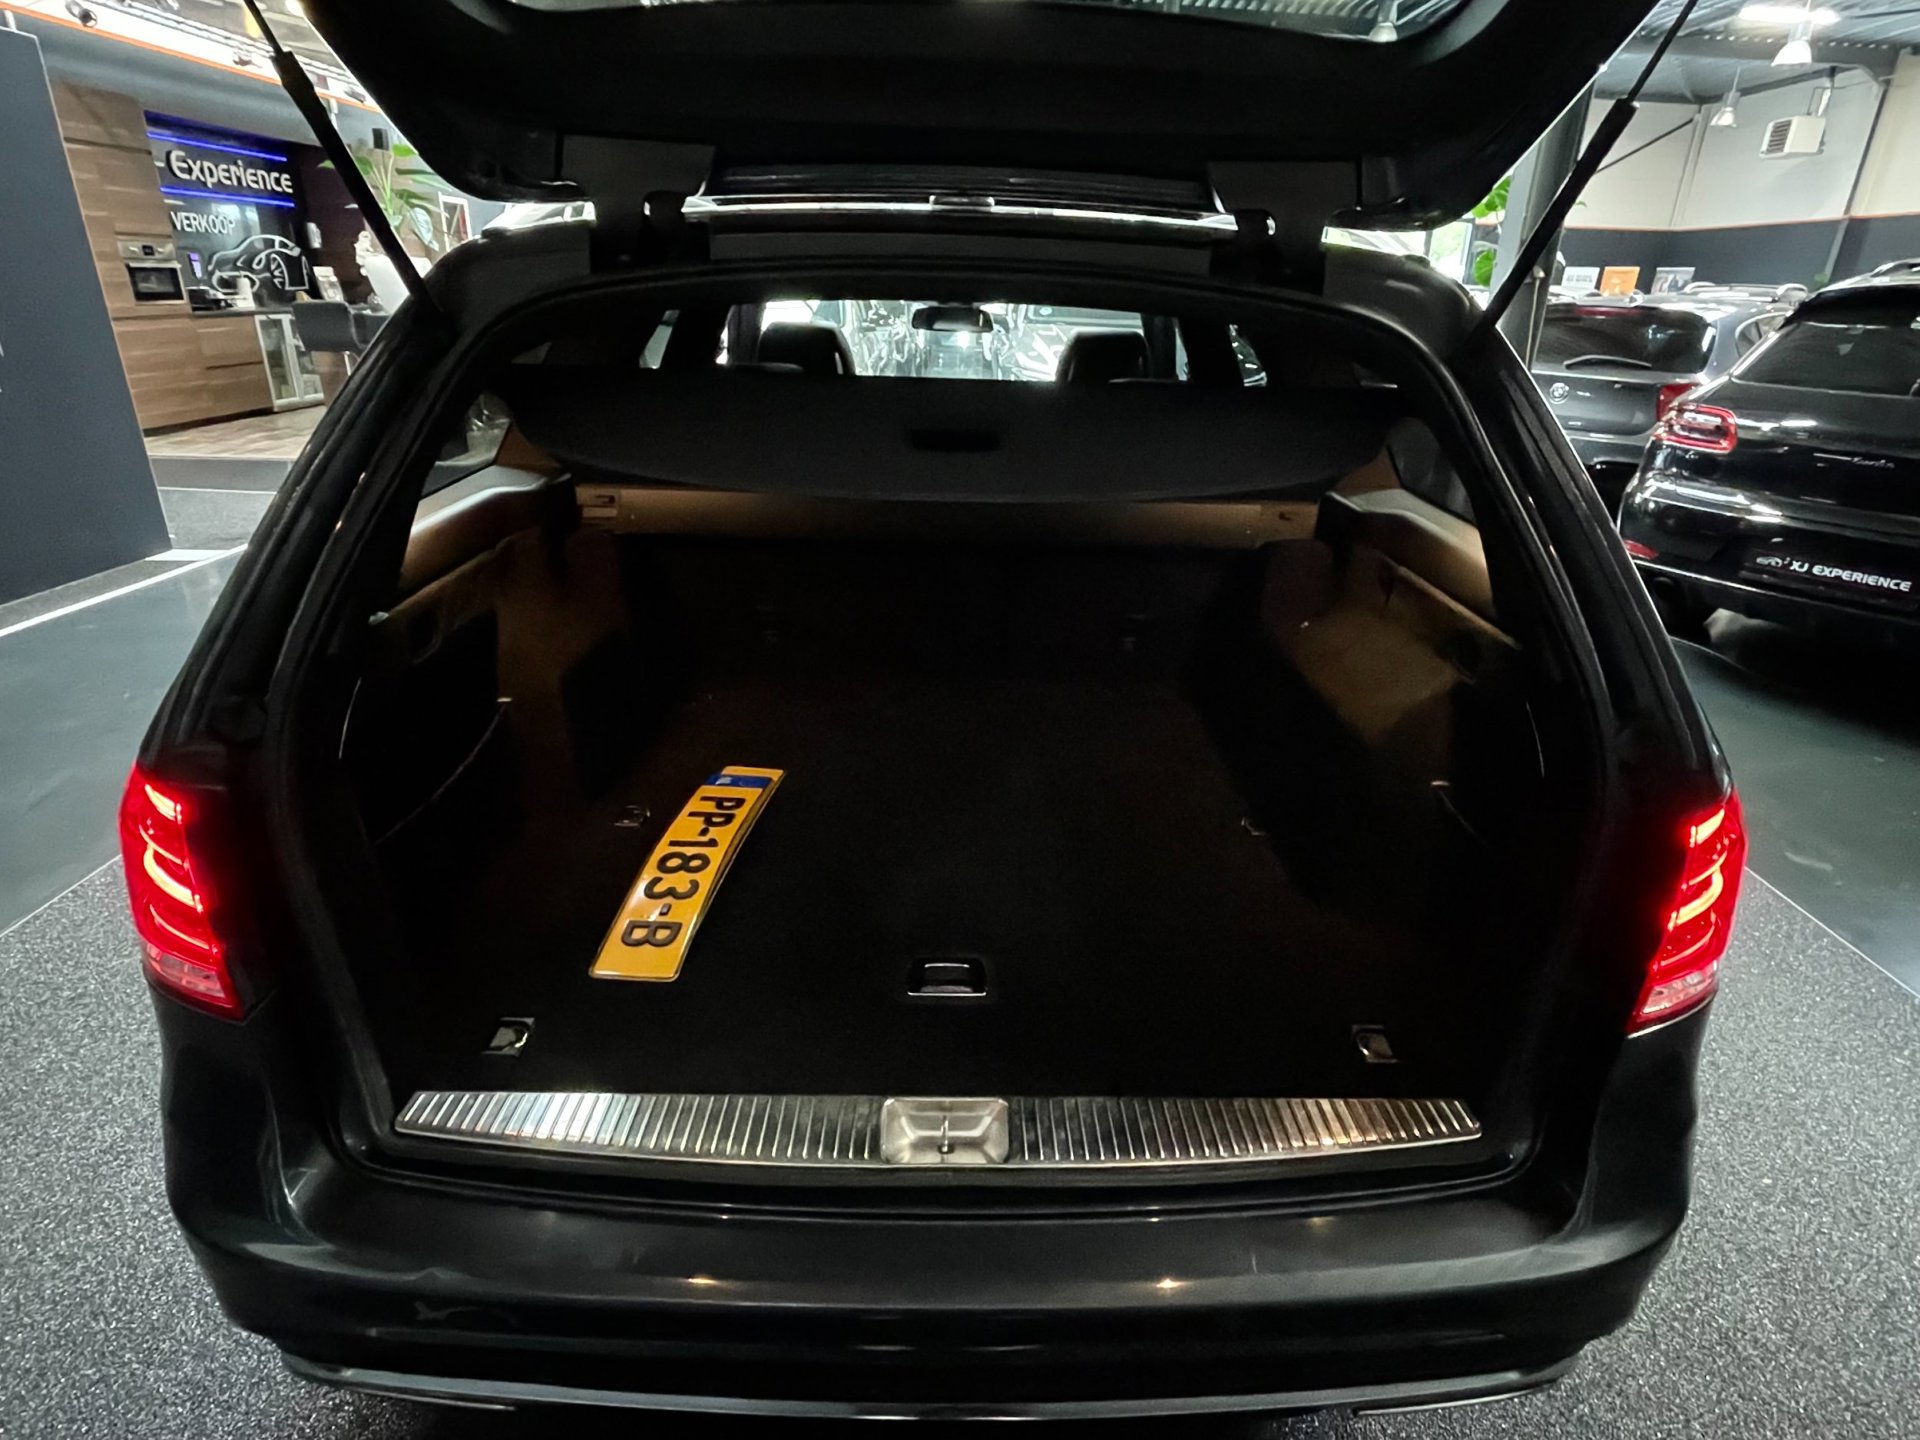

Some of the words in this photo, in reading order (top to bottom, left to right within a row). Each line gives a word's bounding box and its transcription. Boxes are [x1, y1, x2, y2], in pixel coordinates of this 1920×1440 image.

[169, 150, 294, 193] Experience
[170, 211, 236, 234] VERKOOP
[1790, 560, 1809, 573] XJ
[1812, 565, 1912, 592] EXPERIENCE
[621, 796, 746, 947] PP-183-B
